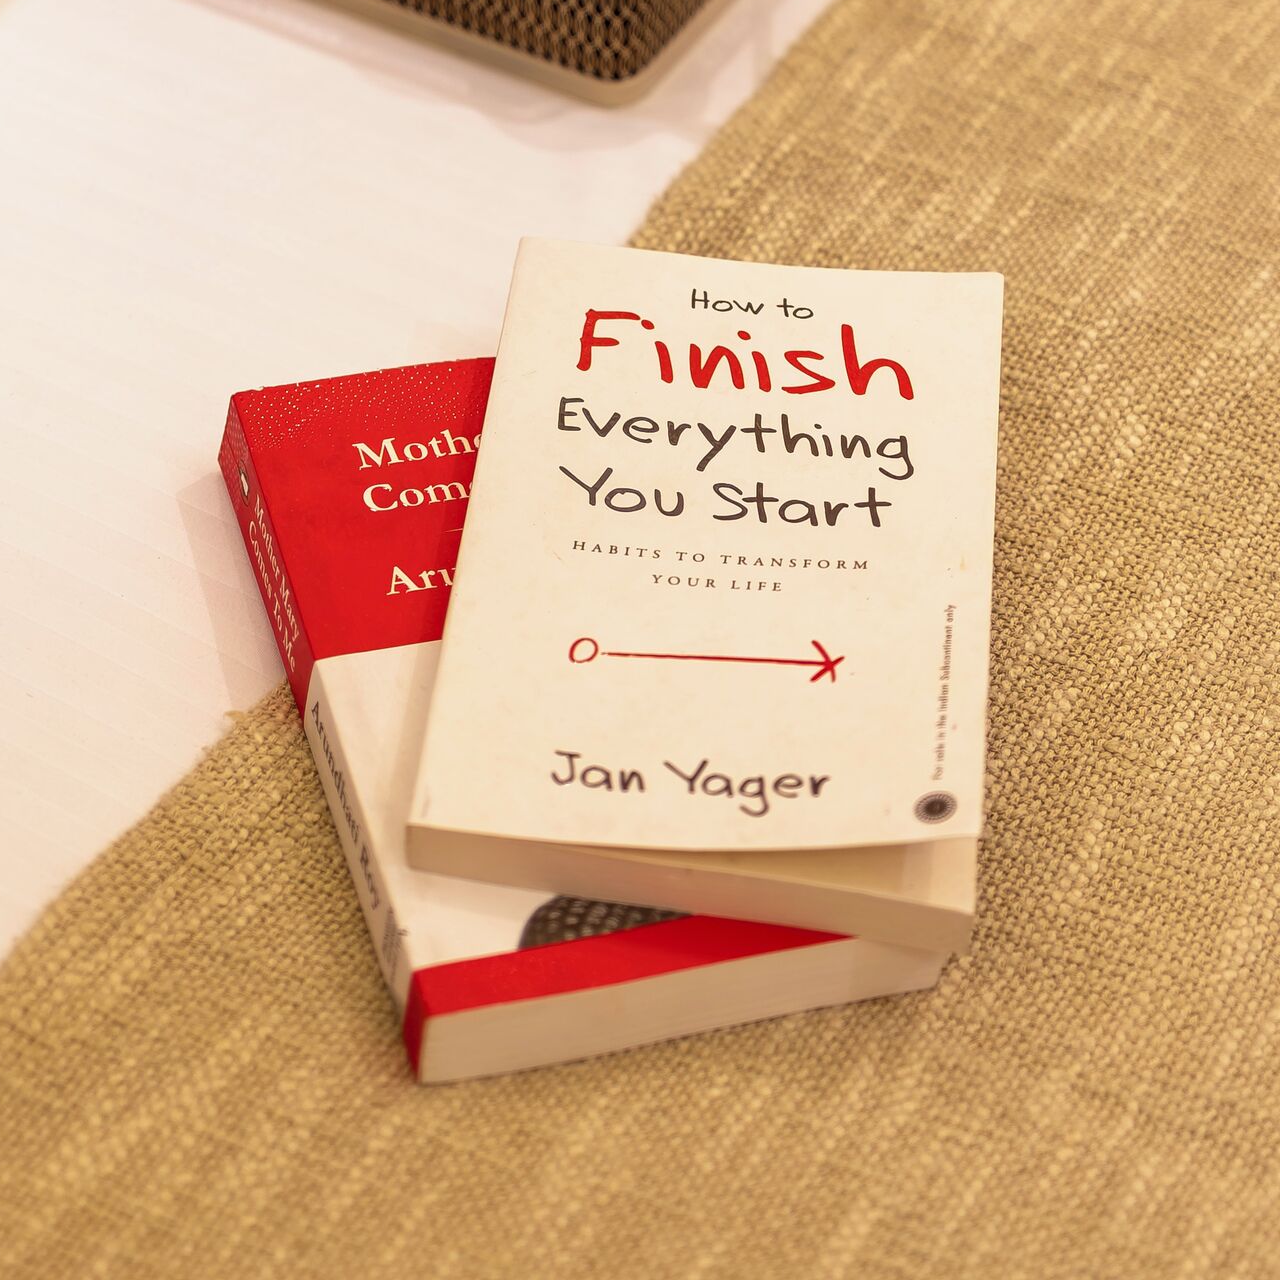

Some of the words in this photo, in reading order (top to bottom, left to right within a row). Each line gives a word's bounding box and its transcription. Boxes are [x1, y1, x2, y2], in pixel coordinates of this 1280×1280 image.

[690, 288, 765, 316] How
[776, 297, 814, 320] to
[576, 308, 914, 401] Finish
[557, 396, 915, 481] Everything
[362, 481, 472, 512] Com
[558, 465, 685, 517] You
[712, 481, 892, 528] Start
[255, 494, 281, 581] Mother
[279, 575, 300, 642] Mary
[572, 540, 661, 559] HABITS
[676, 551, 705, 564] TO
[720, 554, 869, 570] TRANSFORM
[652, 574, 717, 589] YOUR
[730, 579, 783, 592] LIFE
[249, 521, 273, 599] Comes
[273, 593, 283, 632] To
[282, 627, 297, 673] Me
[944, 604, 957, 623] only
[939, 625, 953, 681] Subcontinent
[312, 700, 361, 845] Arundhati
[360, 843, 381, 911] Roy
[551, 750, 646, 793] Jan
[663, 758, 831, 818] Yager
